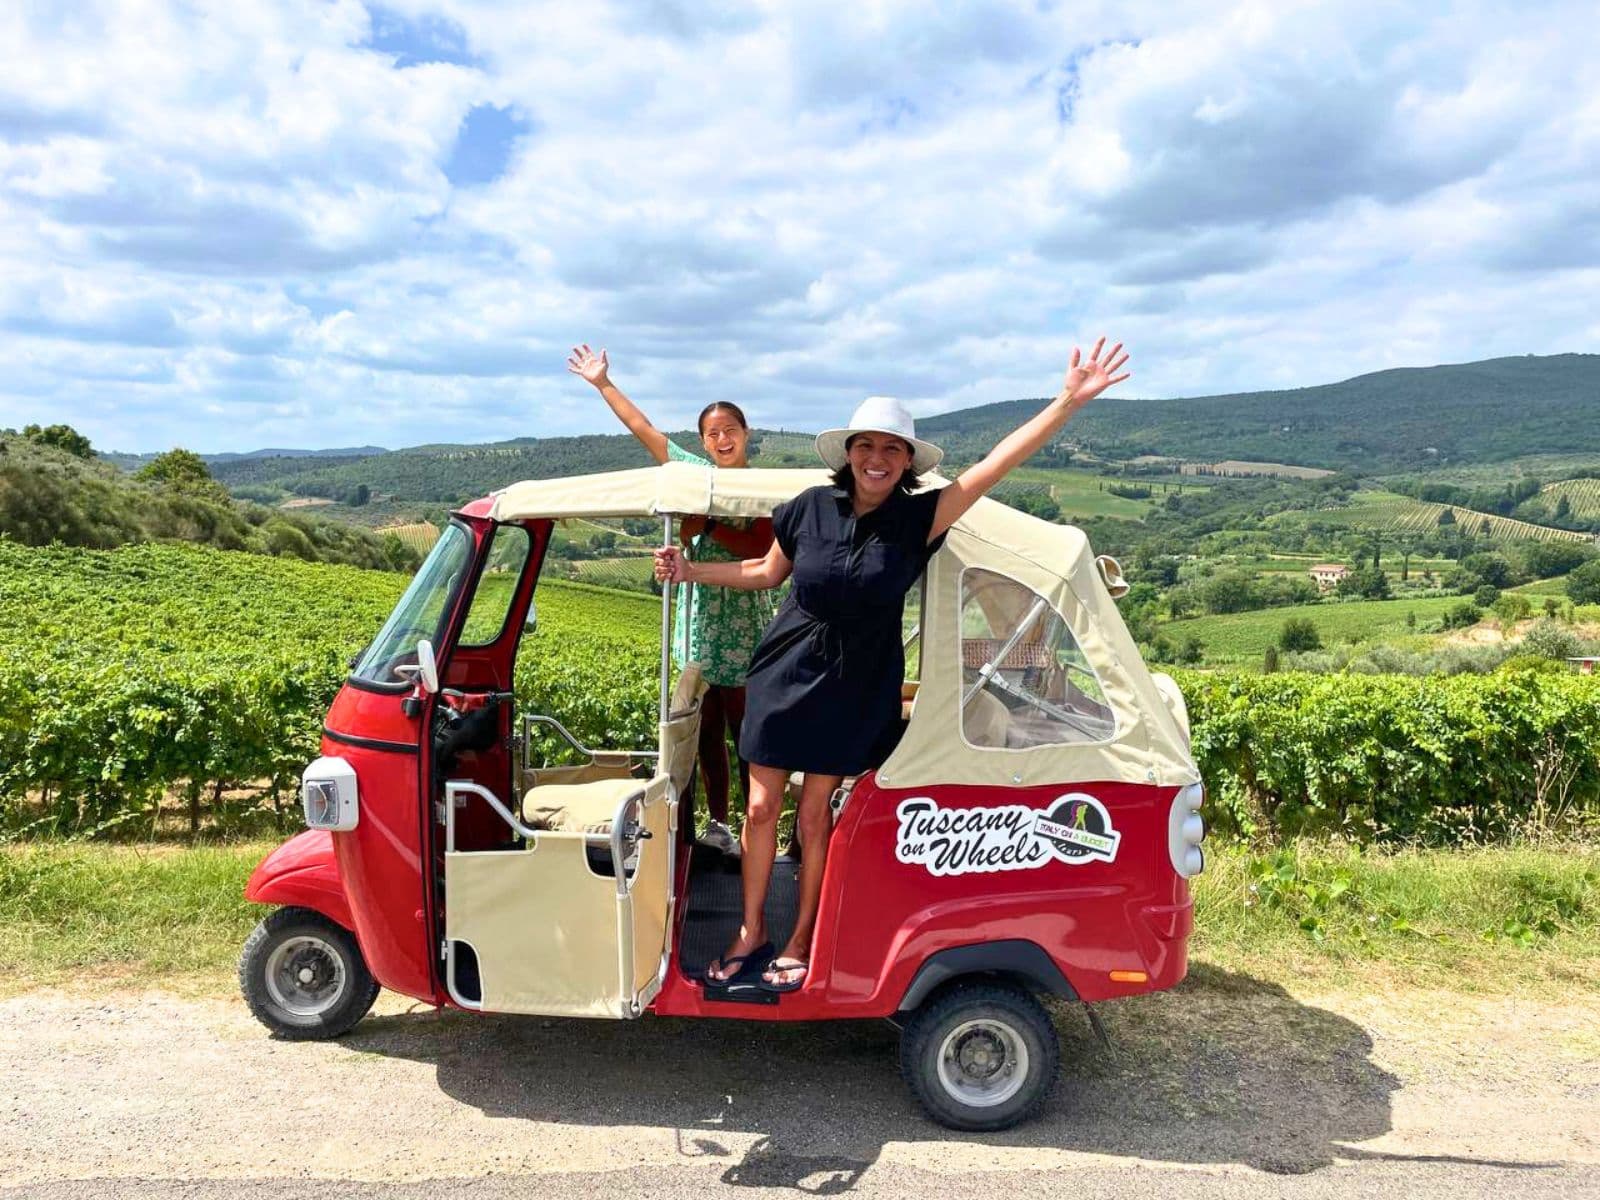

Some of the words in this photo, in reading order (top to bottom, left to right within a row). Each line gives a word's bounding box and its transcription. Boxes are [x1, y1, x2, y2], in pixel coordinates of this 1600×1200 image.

[903, 803, 1031, 840] Tuscany
[901, 842, 925, 857] on
[929, 832, 1046, 870] Wheels
